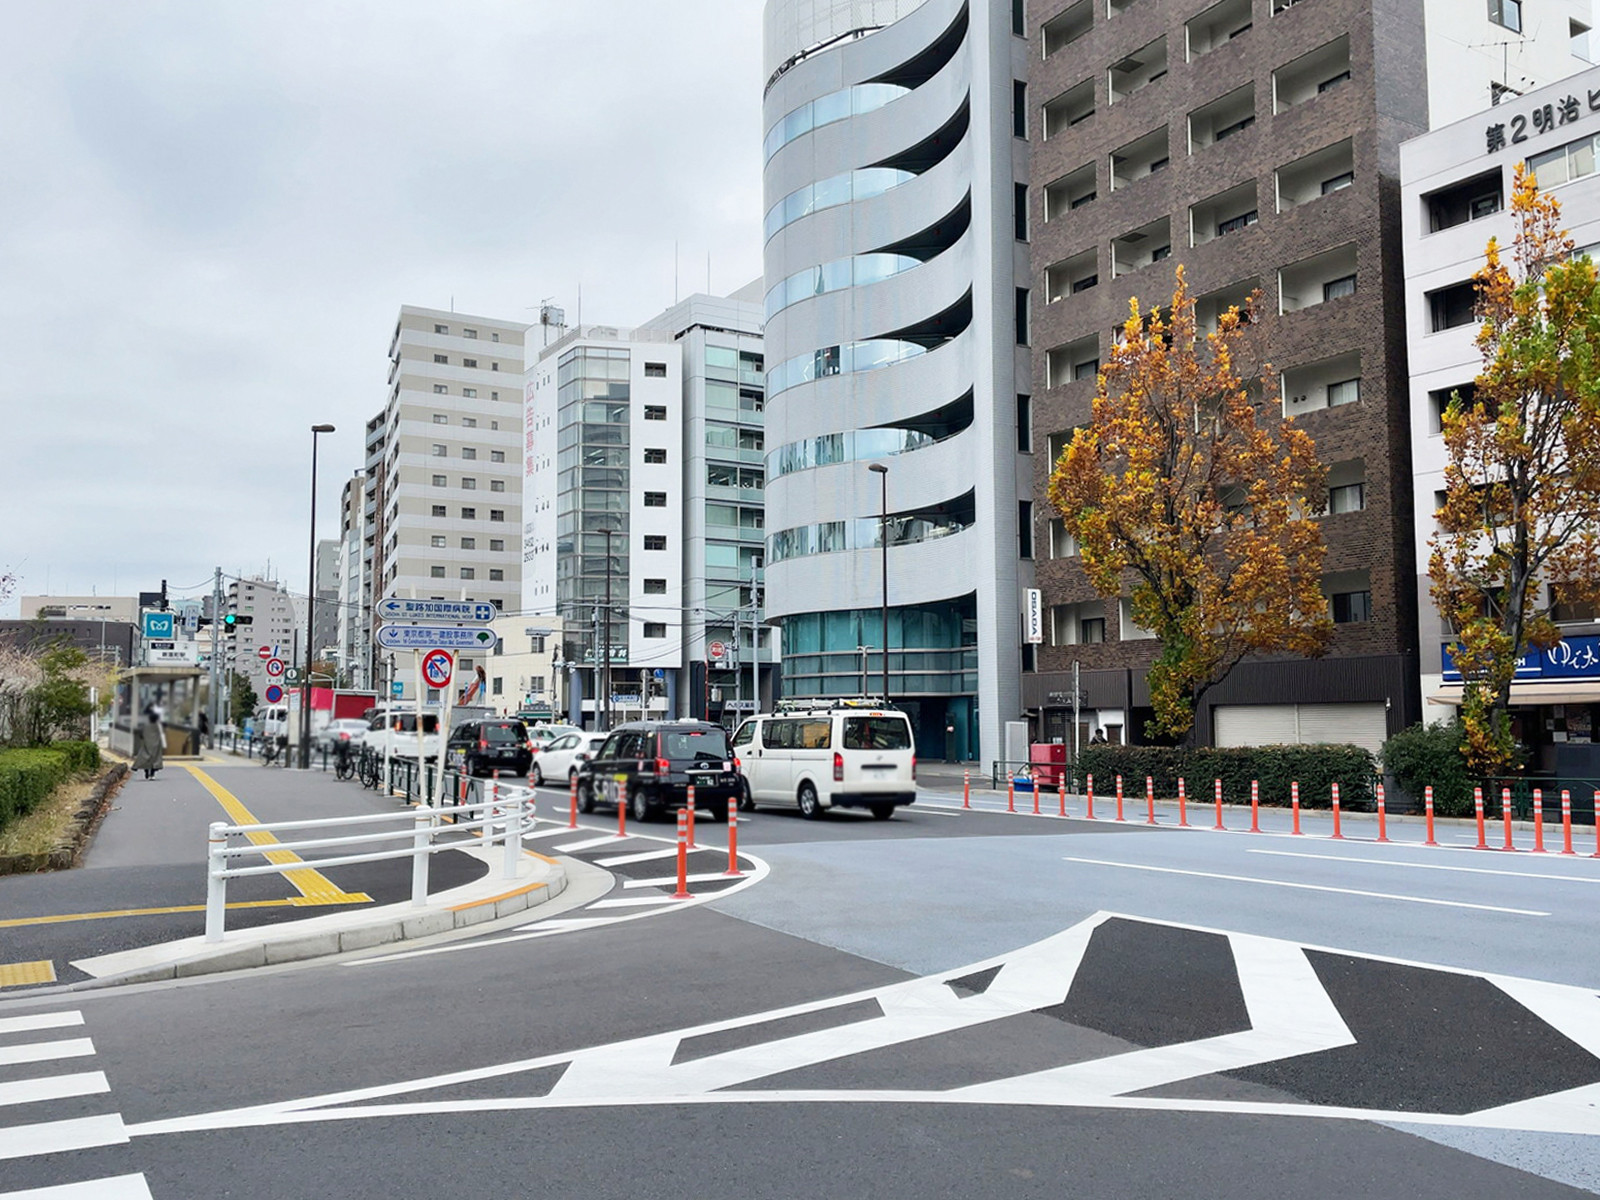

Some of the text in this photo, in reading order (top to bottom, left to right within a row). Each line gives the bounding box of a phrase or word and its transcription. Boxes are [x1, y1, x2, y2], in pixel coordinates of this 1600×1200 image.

[405, 602, 471, 614] 聖路加国際病院
[1547, 640, 1600, 669] ゆで太
